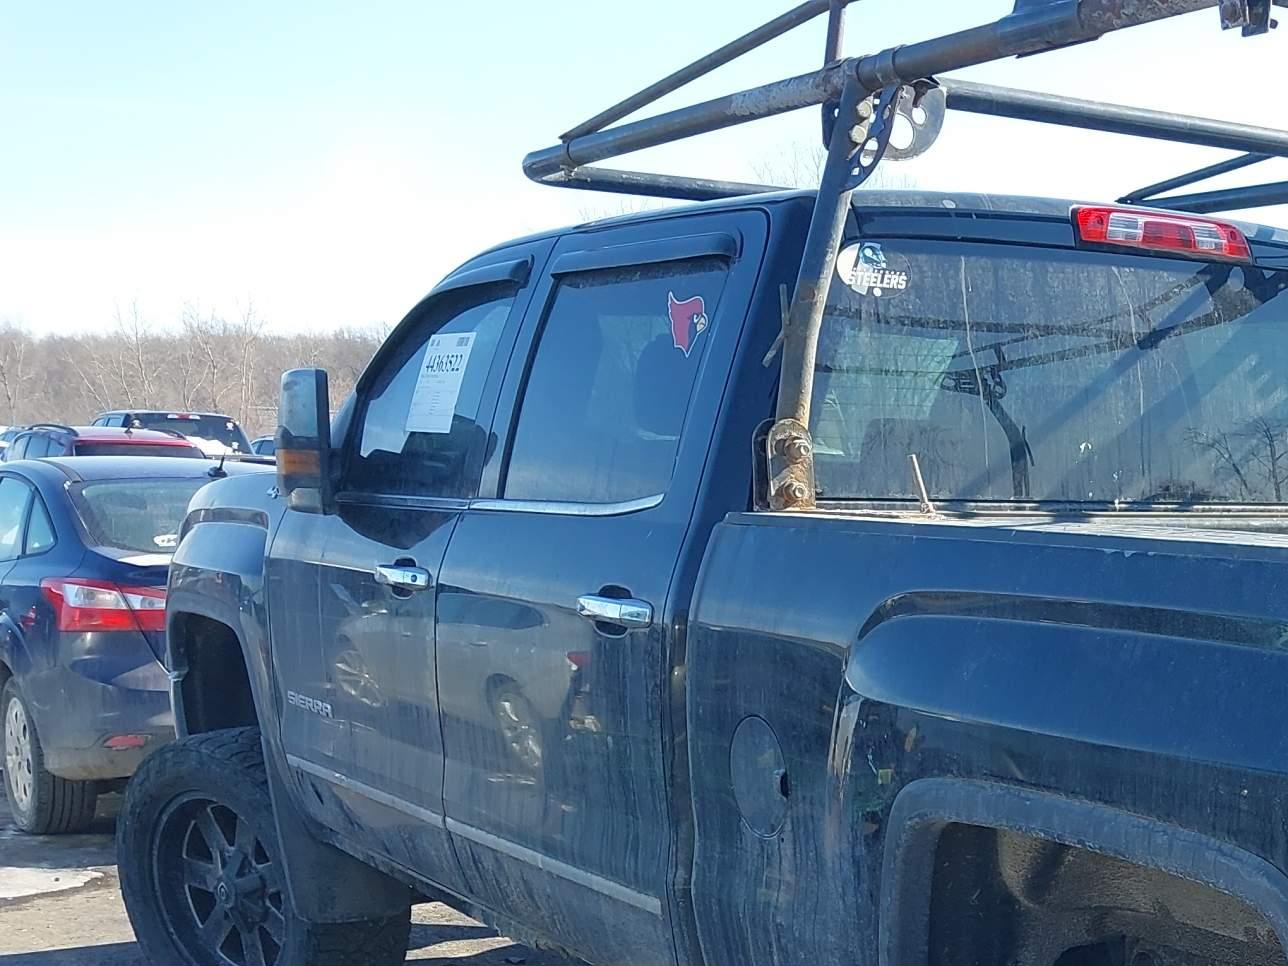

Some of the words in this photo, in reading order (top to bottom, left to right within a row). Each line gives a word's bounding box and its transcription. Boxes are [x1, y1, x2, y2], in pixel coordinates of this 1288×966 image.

[848, 270, 907, 290] STEELERS
[426, 353, 463, 372] 44363522
[287, 690, 333, 719] SIERRA
